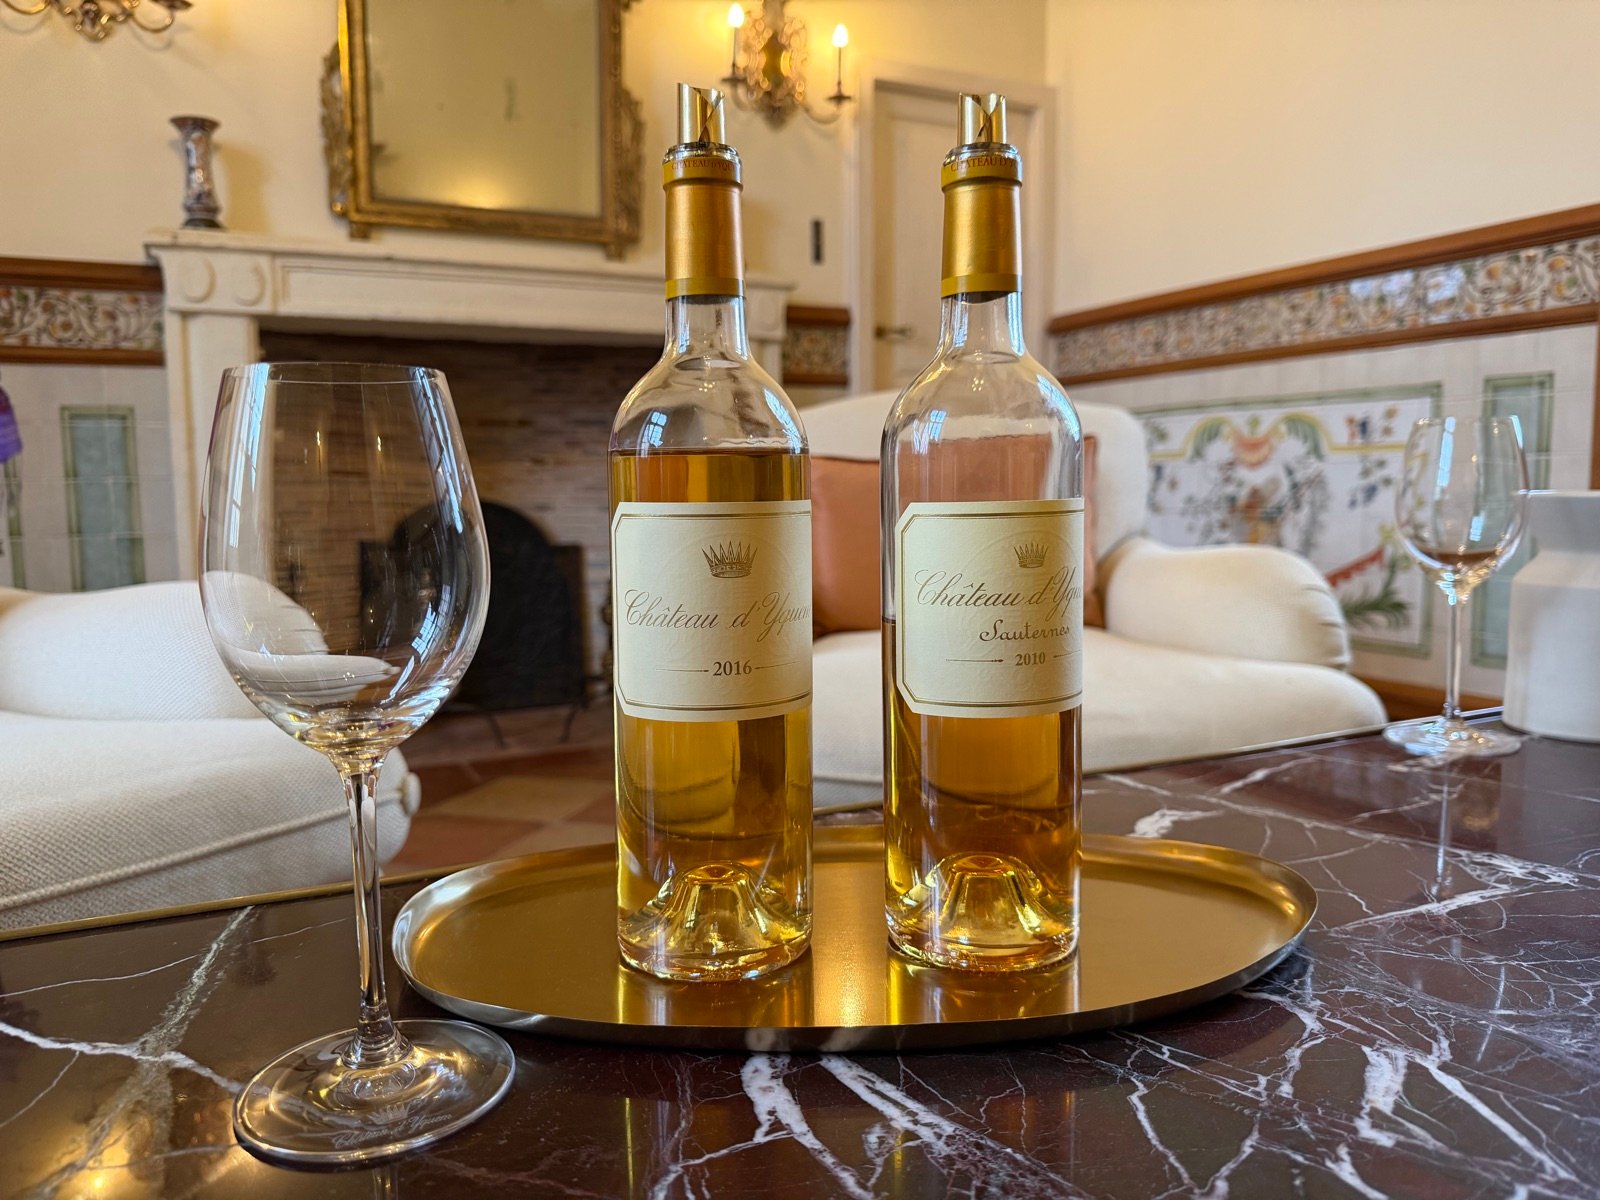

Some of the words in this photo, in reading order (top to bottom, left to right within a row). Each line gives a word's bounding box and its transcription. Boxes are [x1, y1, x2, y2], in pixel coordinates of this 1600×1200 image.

[914, 569, 1025, 607] Château
[624, 589, 720, 629] Château
[979, 619, 1070, 642] Sauternes
[712, 660, 753, 677] 2016
[1015, 651, 1046, 666] 2010
